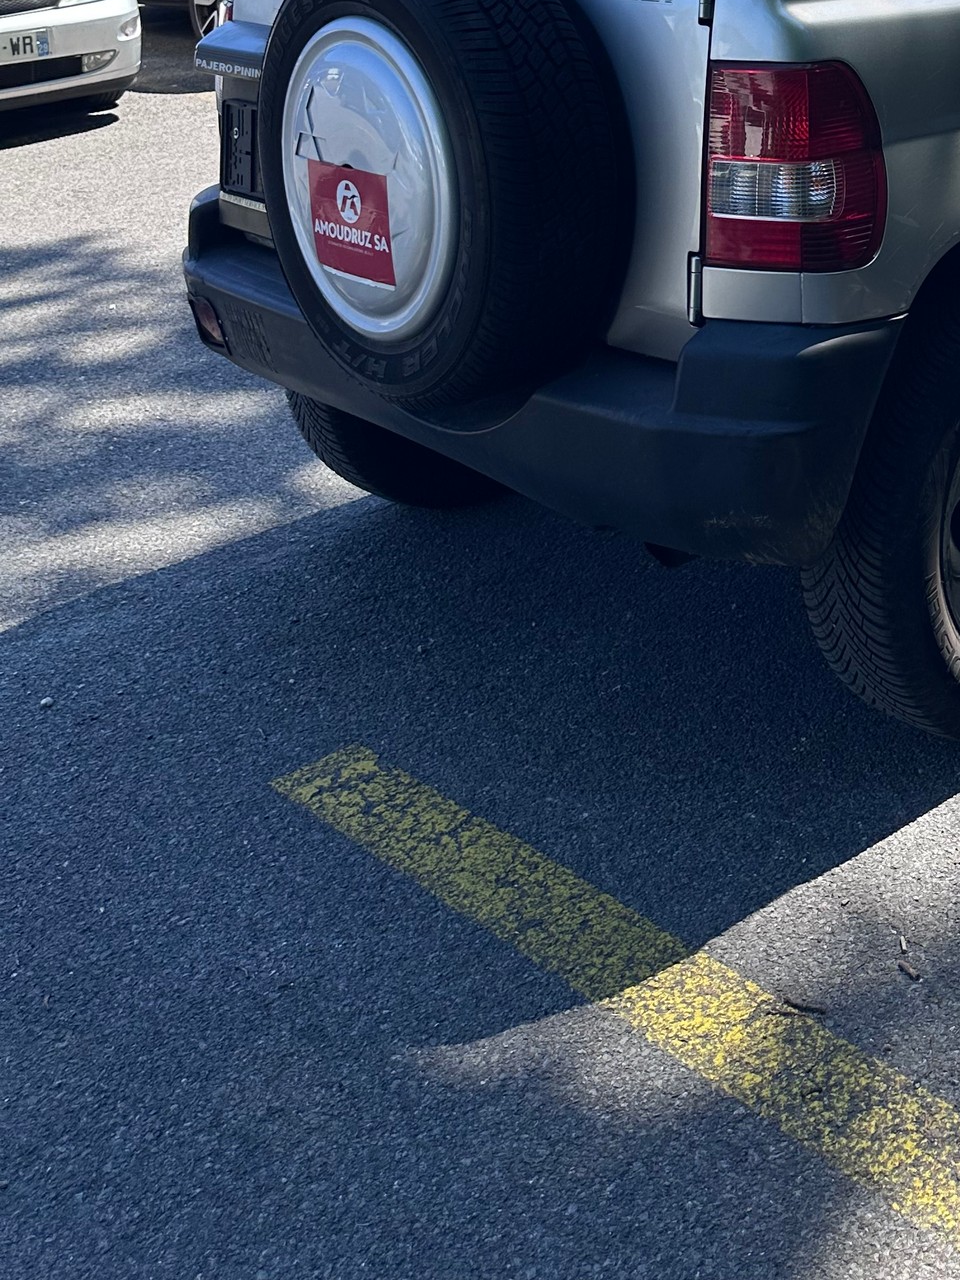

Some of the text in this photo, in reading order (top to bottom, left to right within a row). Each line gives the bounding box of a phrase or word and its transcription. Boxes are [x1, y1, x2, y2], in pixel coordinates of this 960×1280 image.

[195, 58, 262, 79] PAJERO PININ
[314, 218, 372, 249] AMOUDRUZ
[373, 234, 390, 253] SA
[332, 341, 387, 379] H/T
